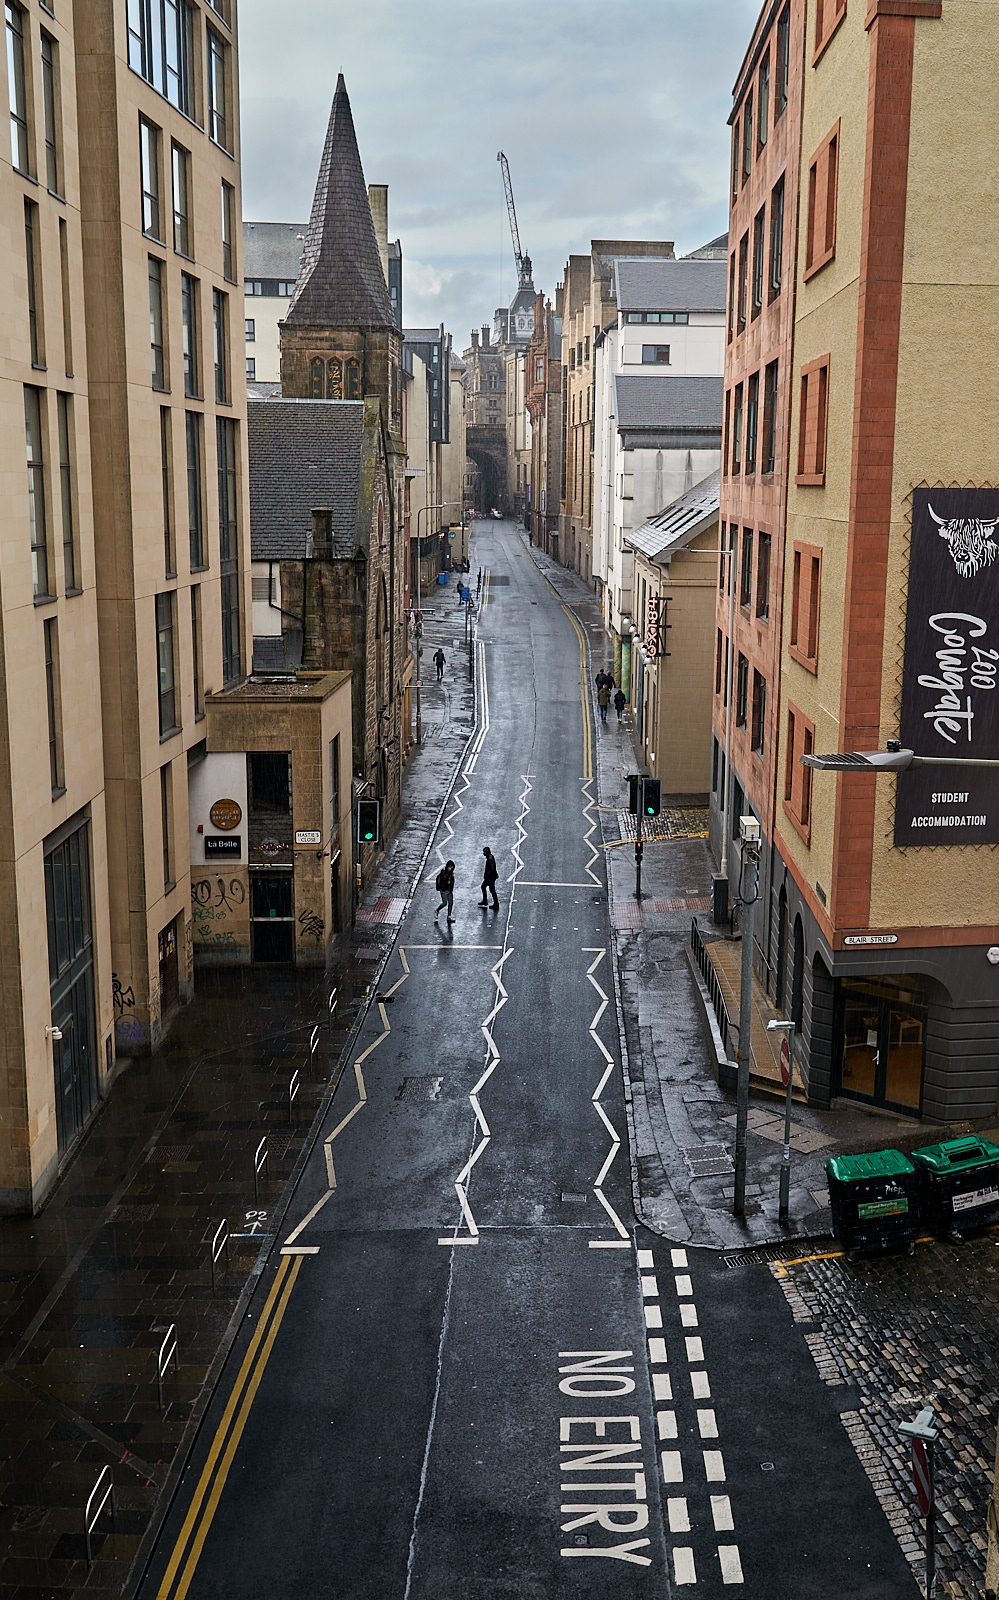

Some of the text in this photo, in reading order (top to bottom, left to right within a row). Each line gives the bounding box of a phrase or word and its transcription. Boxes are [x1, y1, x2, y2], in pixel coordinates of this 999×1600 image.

[917, 612, 987, 744] Cowgate
[970, 646, 999, 689] 200
[931, 792, 969, 803] STUDENT
[911, 815, 987, 827] ACCOMMODATION
[558, 1351, 652, 1566] NO ENTRY
